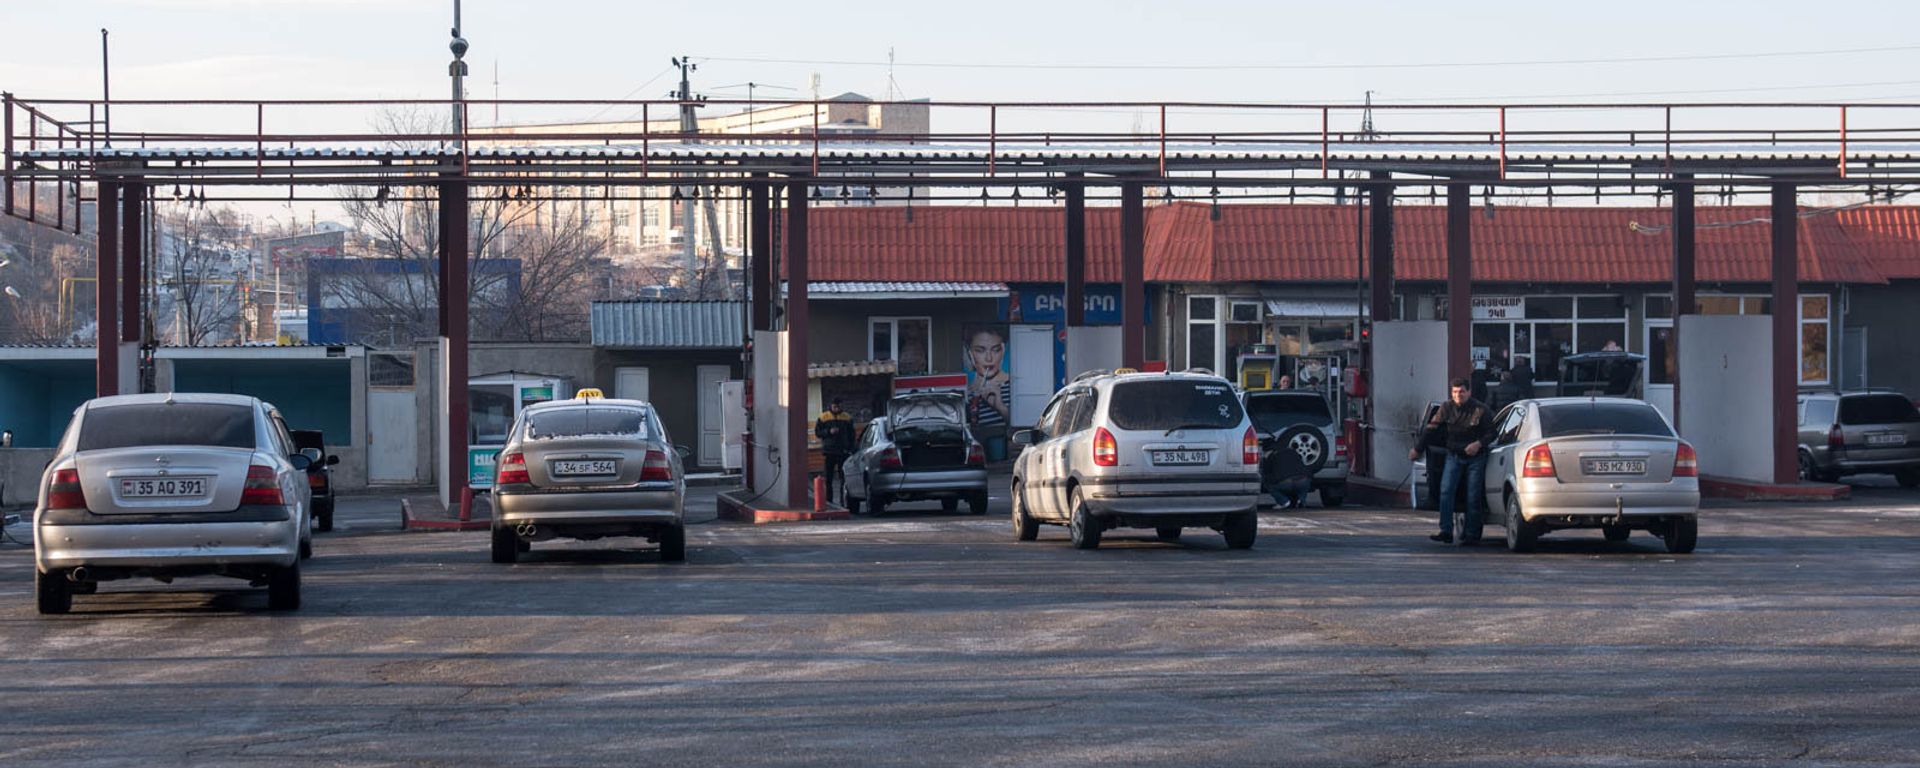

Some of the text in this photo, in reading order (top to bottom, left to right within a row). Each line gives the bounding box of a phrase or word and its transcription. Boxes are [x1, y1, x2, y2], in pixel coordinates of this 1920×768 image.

[1034, 294, 1115, 311] ԲԻՐՈ
[1164, 452, 1175, 462] 35
[1191, 452, 1207, 462] 498
[563, 463, 576, 473] 34
[592, 461, 613, 473] 564
[1598, 462, 1609, 472] 35
[138, 481, 153, 495] 35
[157, 481, 175, 494] AQ
[179, 481, 202, 494] 391
